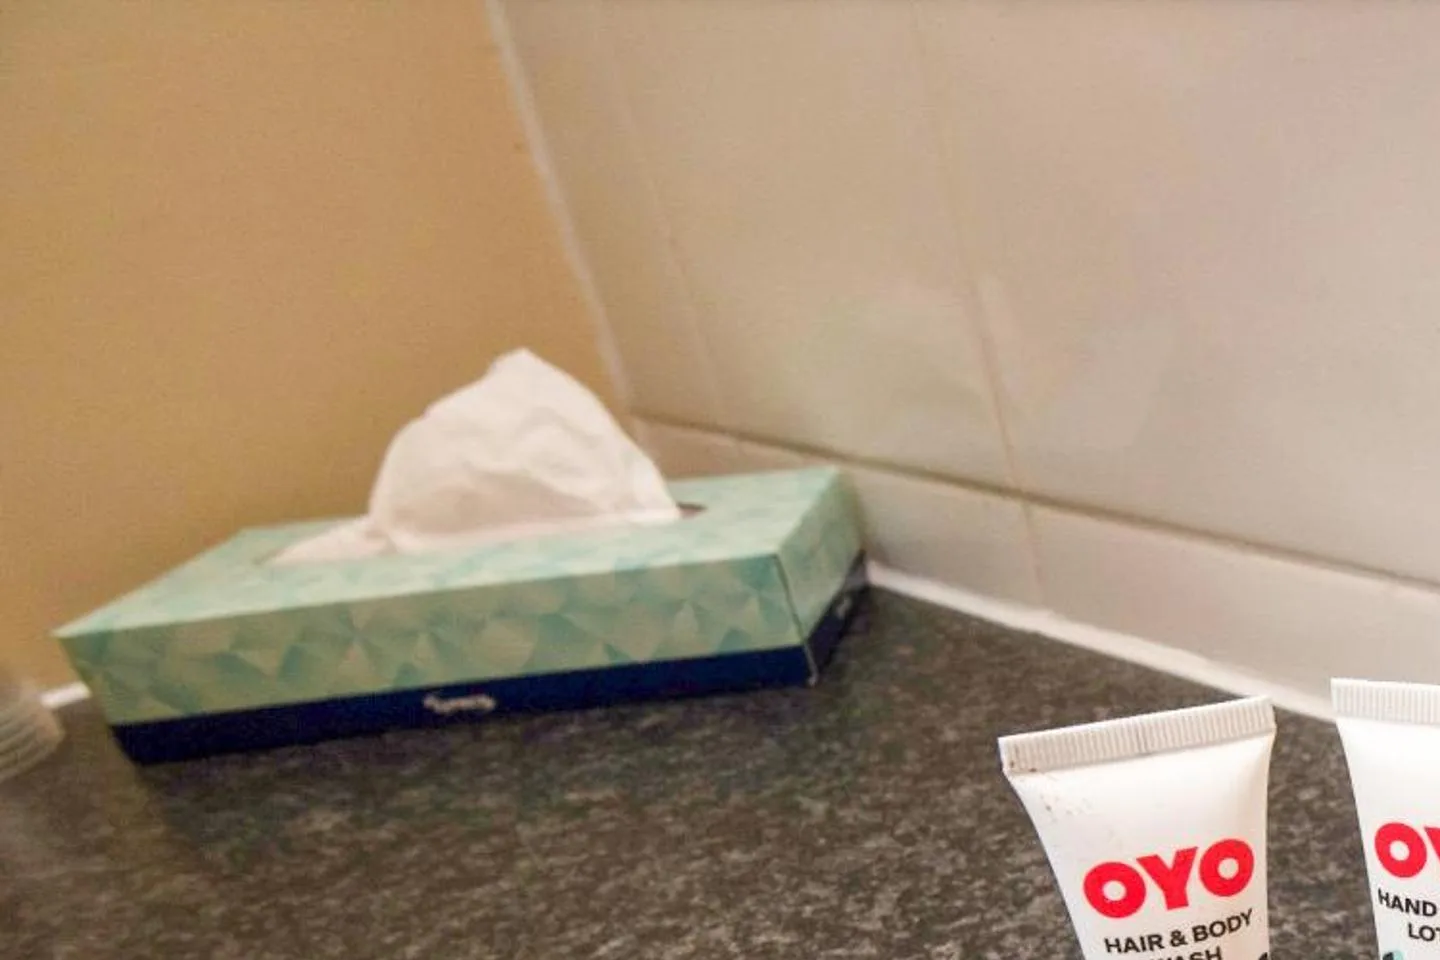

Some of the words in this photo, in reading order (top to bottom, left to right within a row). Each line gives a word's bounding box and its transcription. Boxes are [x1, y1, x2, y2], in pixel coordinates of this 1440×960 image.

[1083, 839, 1254, 919] OYO
[1378, 888, 1437, 917] HAND
[1104, 934, 1165, 953] HAIR
[1170, 929, 1188, 947] &
[1191, 908, 1253, 942] BODY
